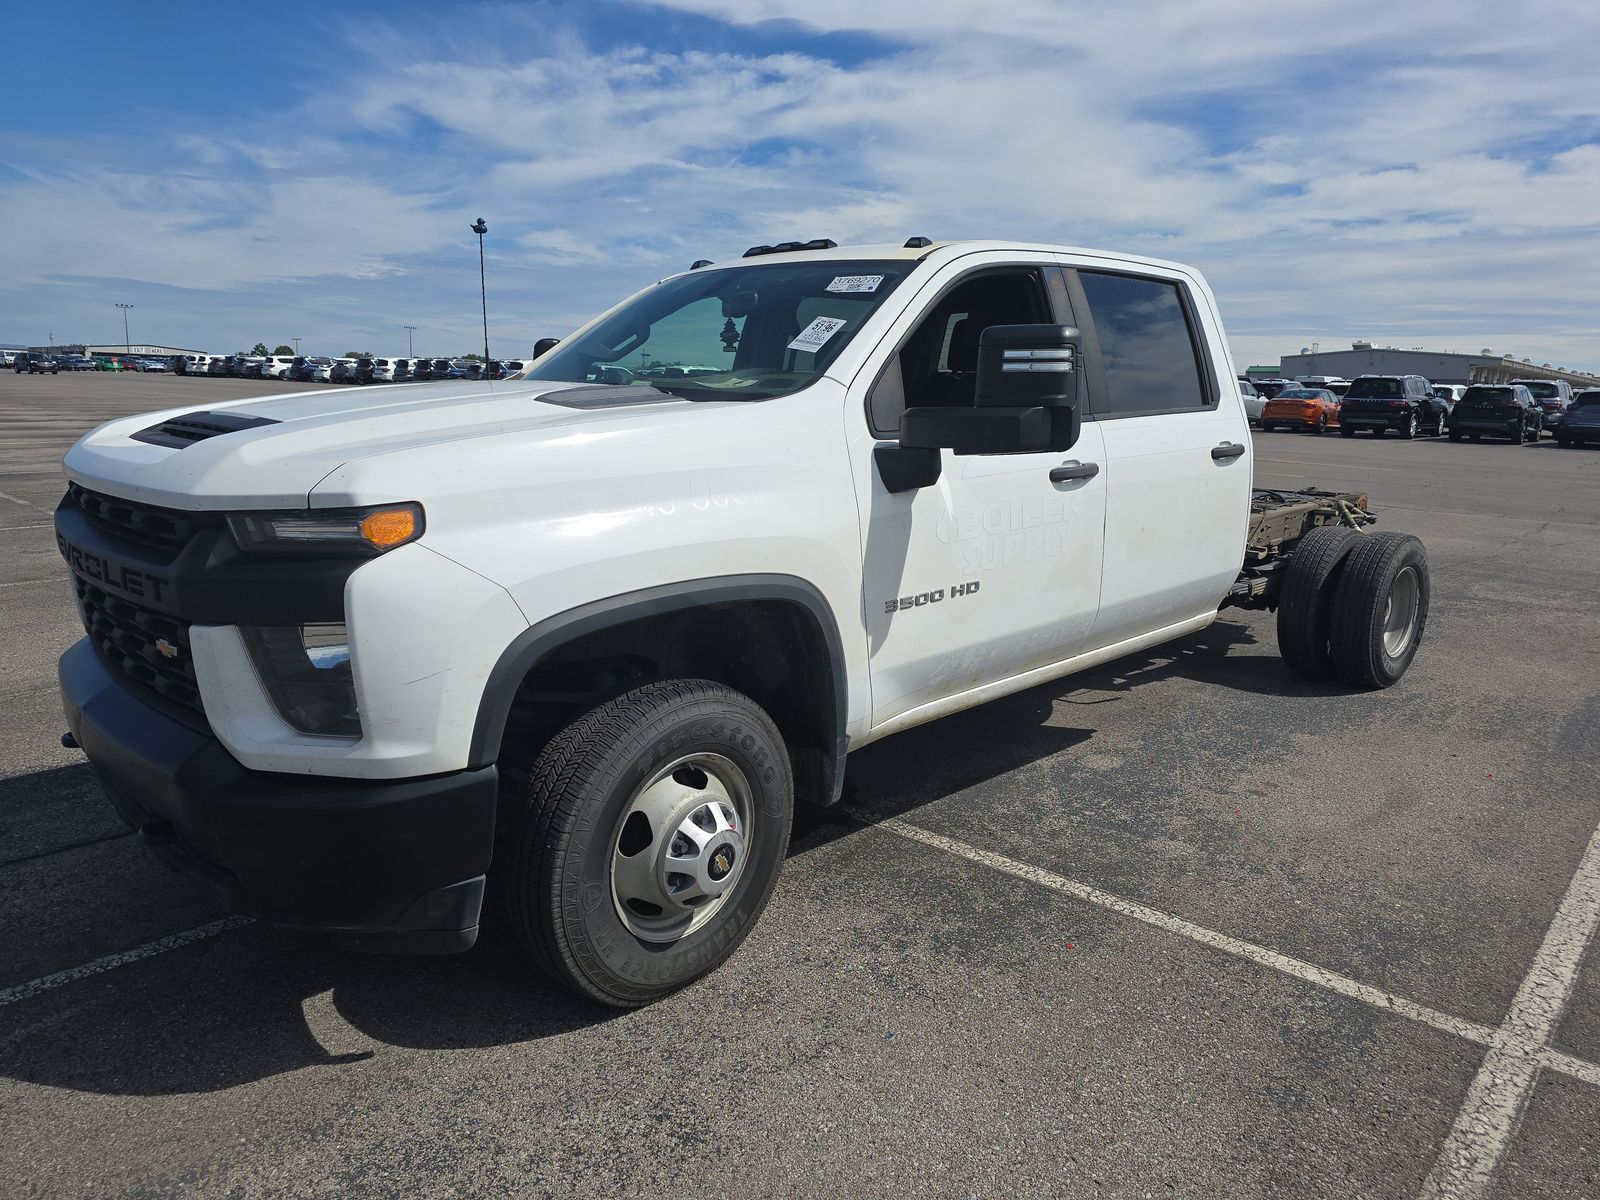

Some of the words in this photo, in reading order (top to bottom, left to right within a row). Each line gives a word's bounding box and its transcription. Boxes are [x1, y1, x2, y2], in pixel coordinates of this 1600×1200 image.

[834, 276, 881, 284] 3769270
[958, 495, 1084, 542] BOILER
[961, 524, 1071, 576] SUPPLY
[884, 588, 945, 614] 3500
[950, 580, 981, 599] HD
[637, 723, 777, 785] Firestone
